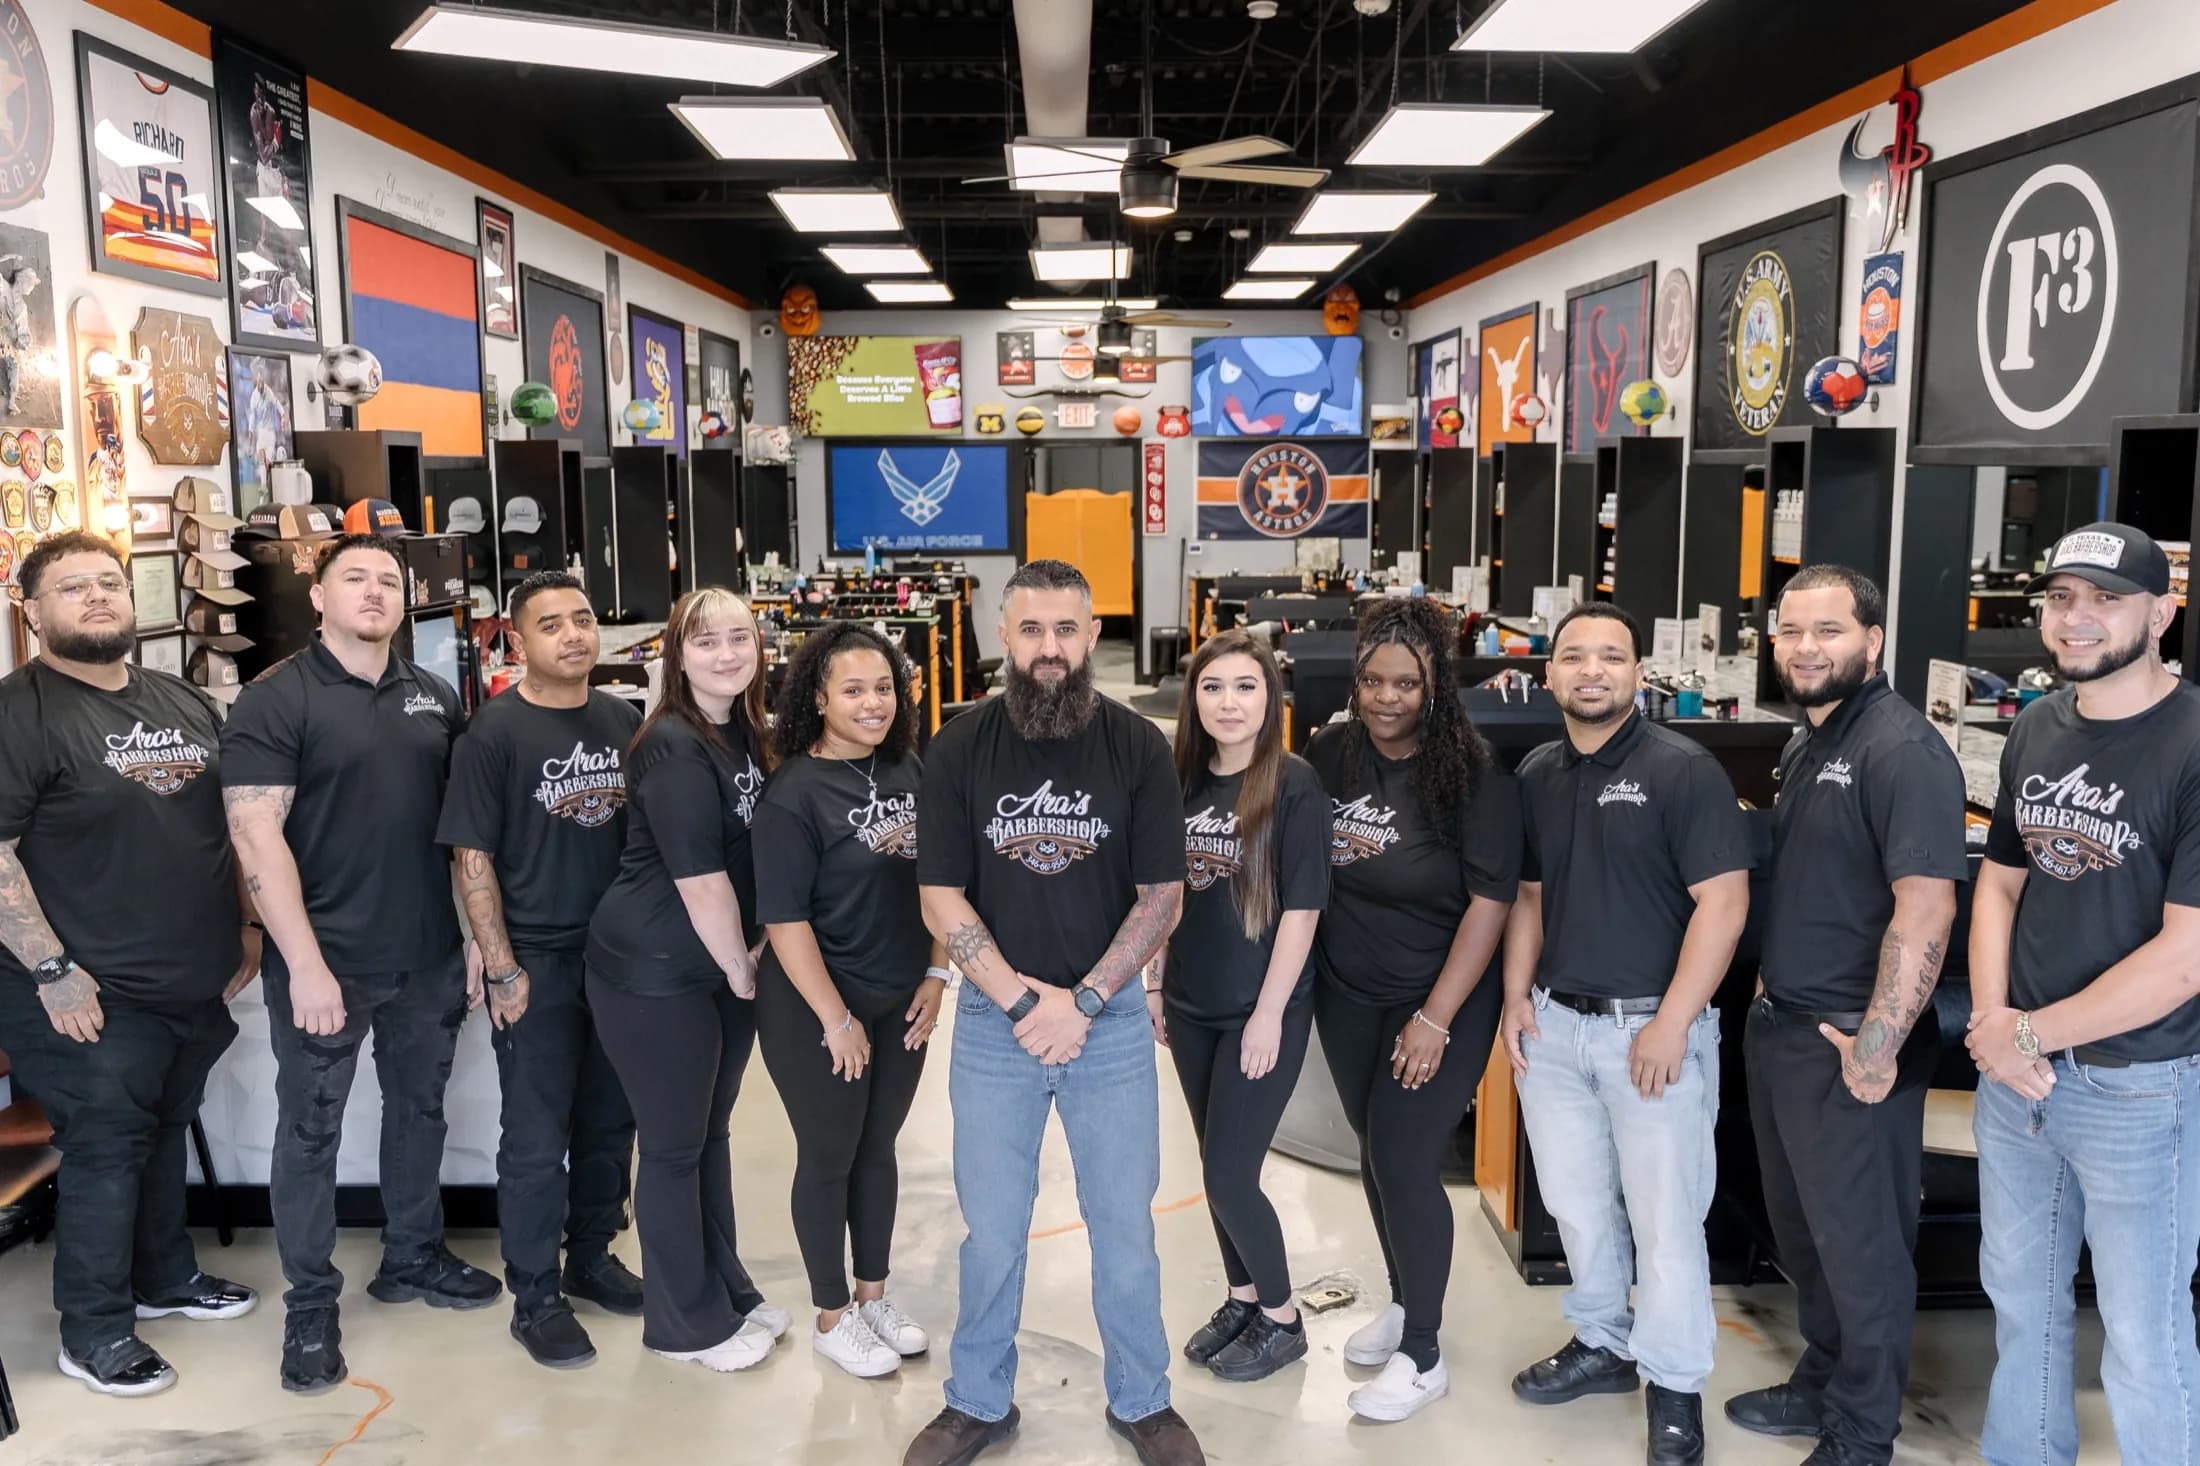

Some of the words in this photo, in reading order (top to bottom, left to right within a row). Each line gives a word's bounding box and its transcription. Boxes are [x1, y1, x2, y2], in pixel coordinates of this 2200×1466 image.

[133, 121, 185, 161] RICHARD
[138, 165, 191, 237] 50
[1756, 258, 1790, 302] ARMY
[1863, 266, 1900, 293] HOUSTON
[160, 313, 201, 368] Ara's
[836, 375, 873, 384] Because
[874, 375, 915, 387] Everyone
[839, 385, 879, 393] Deserves
[881, 385, 888, 393] A
[1064, 407, 1090, 426] EXIT
[1735, 379, 1785, 429] VETERAN
[1250, 450, 1316, 476] HOUSTON
[1253, 509, 1312, 530] ASTROS
[895, 535, 925, 548] AIR
[926, 535, 983, 547] FORCE
[105, 721, 184, 751] Ara's
[103, 744, 209, 773] BARBERSHOP
[542, 741, 620, 779] Ara's
[532, 772, 626, 811] BARBERSHO
[997, 779, 1092, 817] Ara's
[2022, 763, 2125, 815] Ara's
[847, 790, 915, 828] Ara's
[983, 817, 1112, 850] BARBERSHOP
[1332, 818, 1401, 850] BERSHOP
